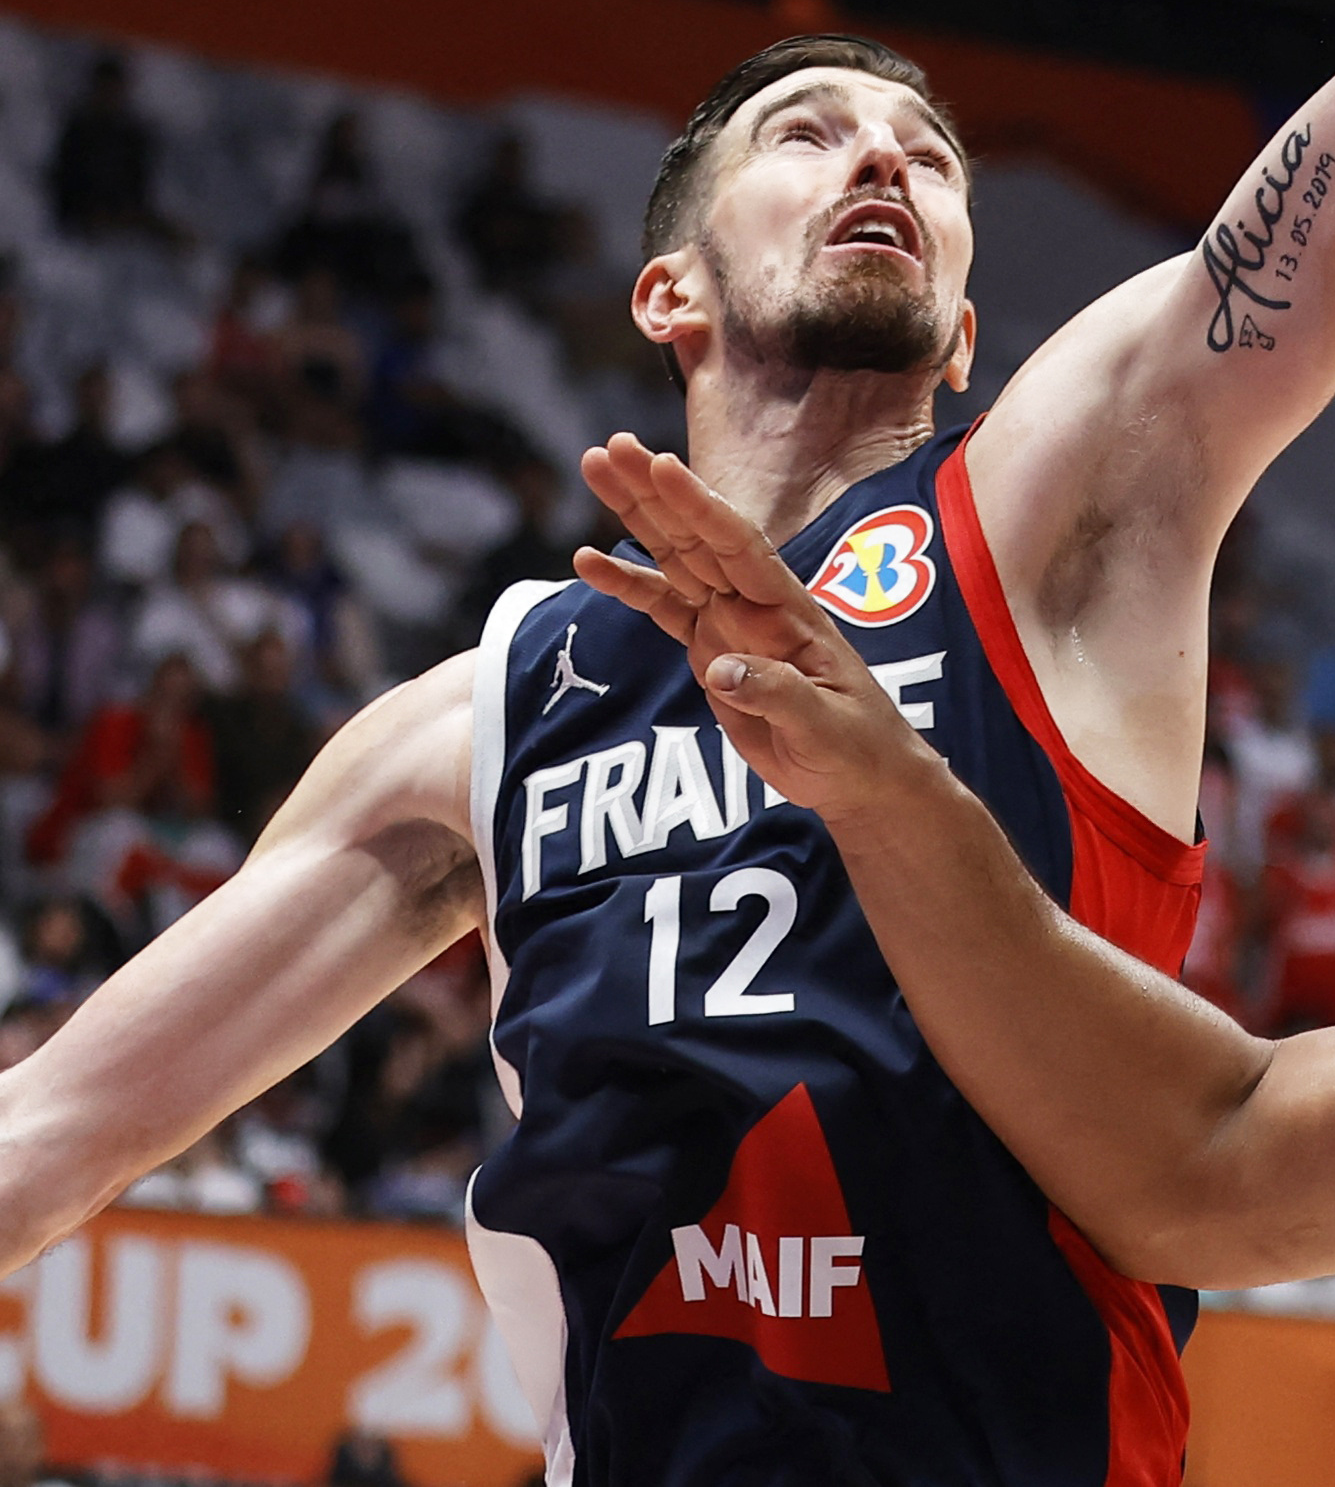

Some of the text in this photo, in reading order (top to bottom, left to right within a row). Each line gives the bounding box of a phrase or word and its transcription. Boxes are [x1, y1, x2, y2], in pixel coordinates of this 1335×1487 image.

[1202, 122, 1311, 352] Alicia
[521, 651, 949, 903] FRAE
[643, 867, 798, 1026] 12
[671, 1224, 866, 1319] MAIF
